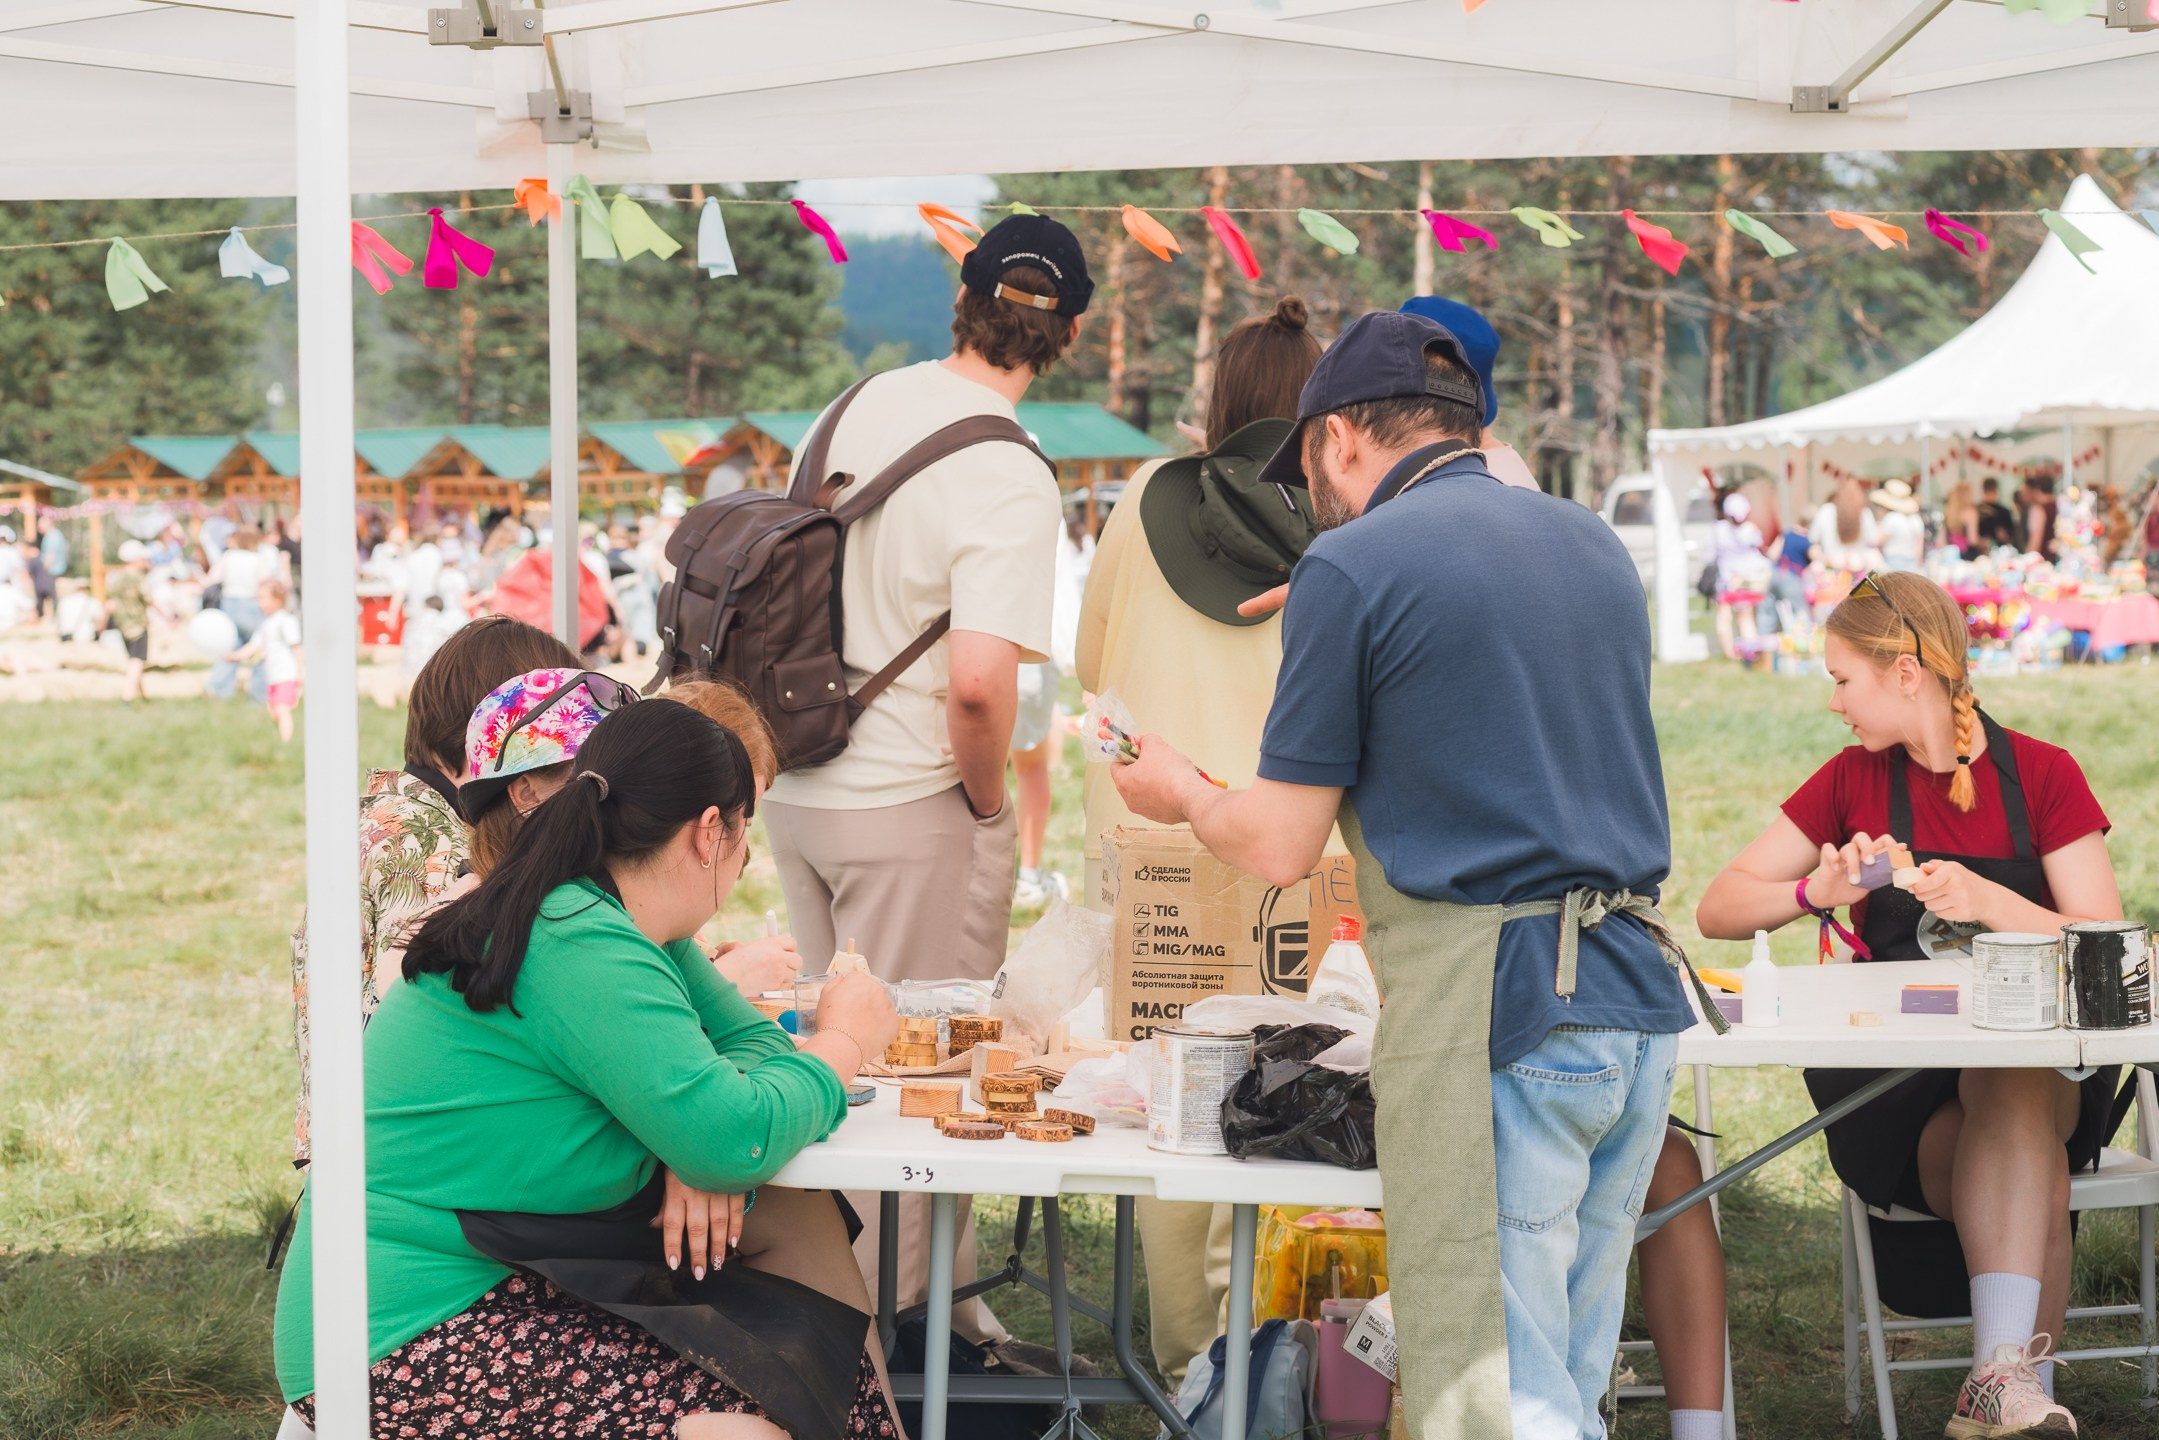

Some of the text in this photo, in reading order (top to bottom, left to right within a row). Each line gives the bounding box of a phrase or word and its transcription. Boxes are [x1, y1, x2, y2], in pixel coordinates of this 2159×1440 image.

[1151, 866, 1191, 875] СДЕЛАНО
[1151, 874, 1191, 883] В РОССИИ
[1153, 904, 1179, 917] TIG
[1153, 924, 1189, 938] MMA
[1153, 943, 1226, 957] MIG/MAG
[1131, 970, 1225, 982] Абсолютная защита
[1131, 980, 1224, 990] воротниковой зоны
